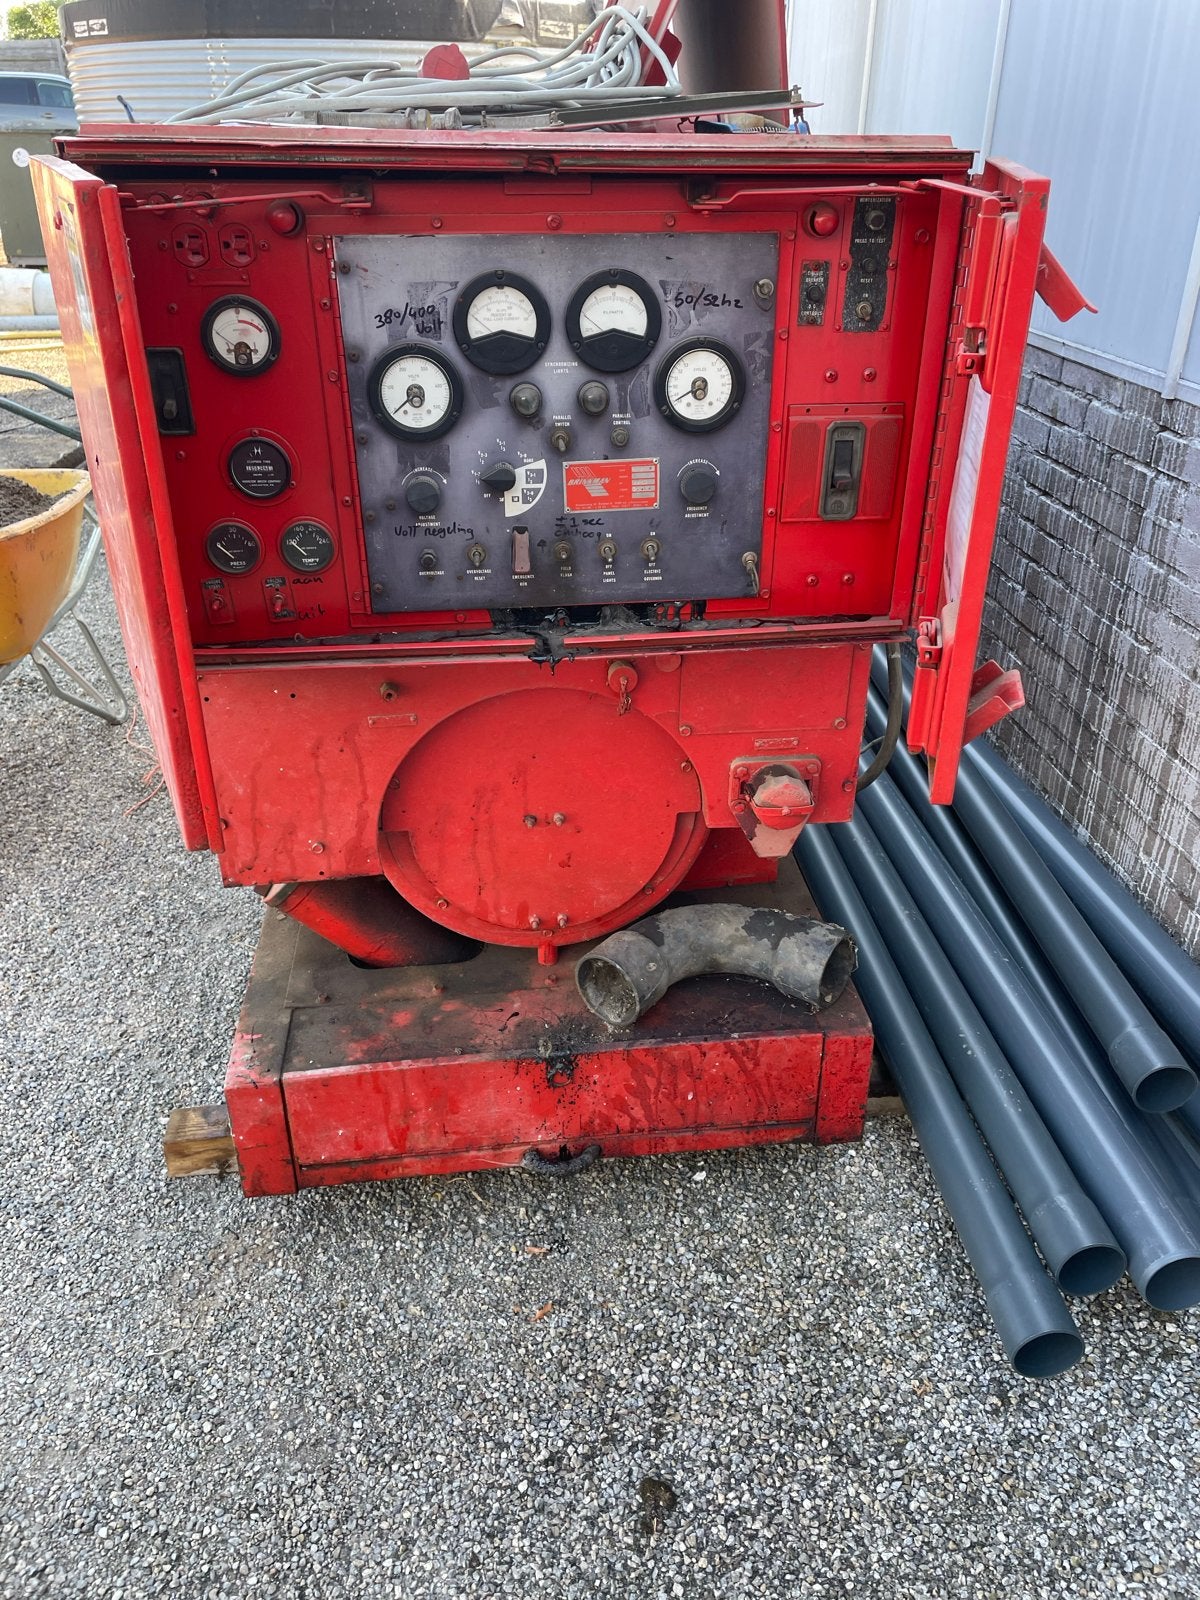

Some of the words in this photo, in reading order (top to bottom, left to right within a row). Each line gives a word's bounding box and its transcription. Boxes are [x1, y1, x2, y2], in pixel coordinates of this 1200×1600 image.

[374, 302, 436, 329] 380/400
[687, 458, 708, 466] INCREASE
[567, 477, 611, 486] BRINKMAN
[582, 517, 605, 526] sec
[292, 577, 323, 585] aan
